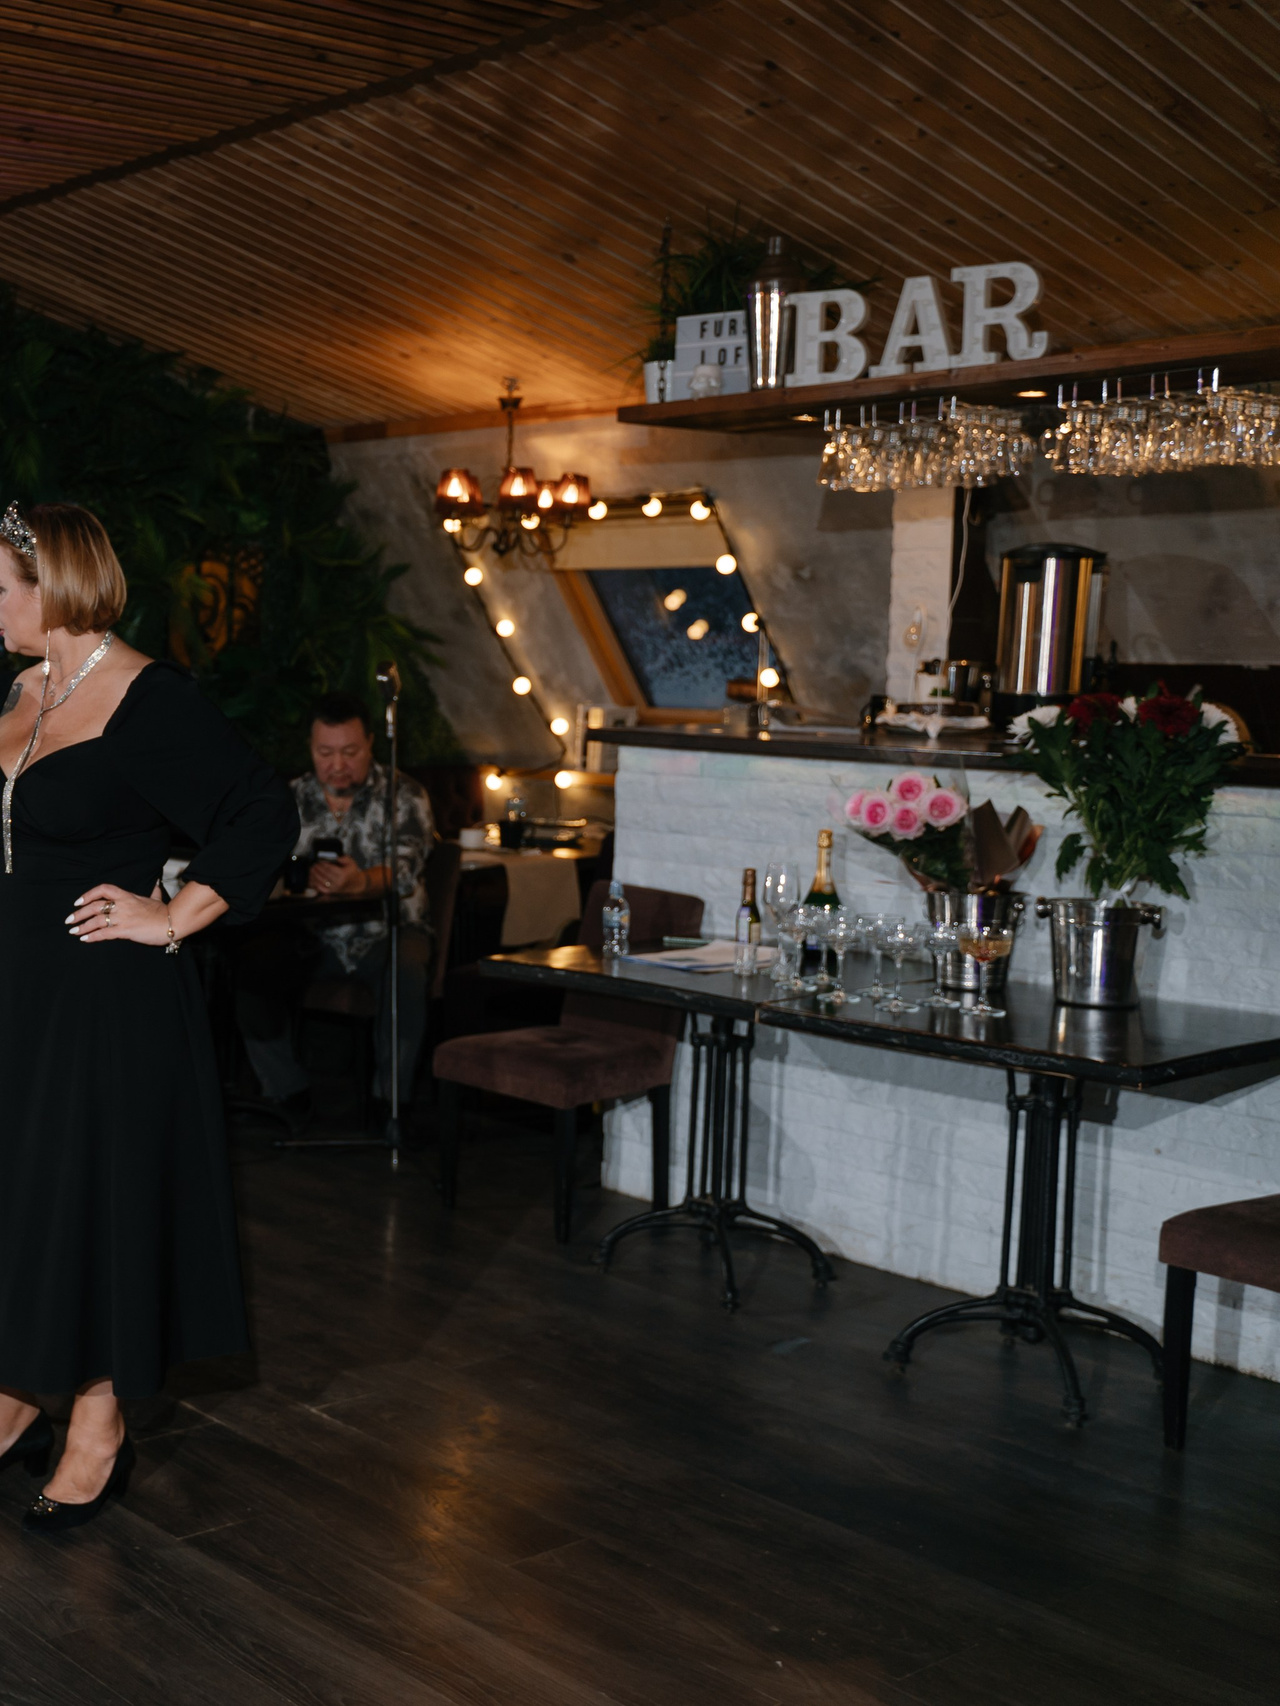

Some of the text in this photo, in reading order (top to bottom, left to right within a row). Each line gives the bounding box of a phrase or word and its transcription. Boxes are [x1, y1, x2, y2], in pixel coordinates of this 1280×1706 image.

[699, 318, 747, 339] FUR
[783, 261, 1048, 388] BAR
[700, 346, 743, 366] LOF
